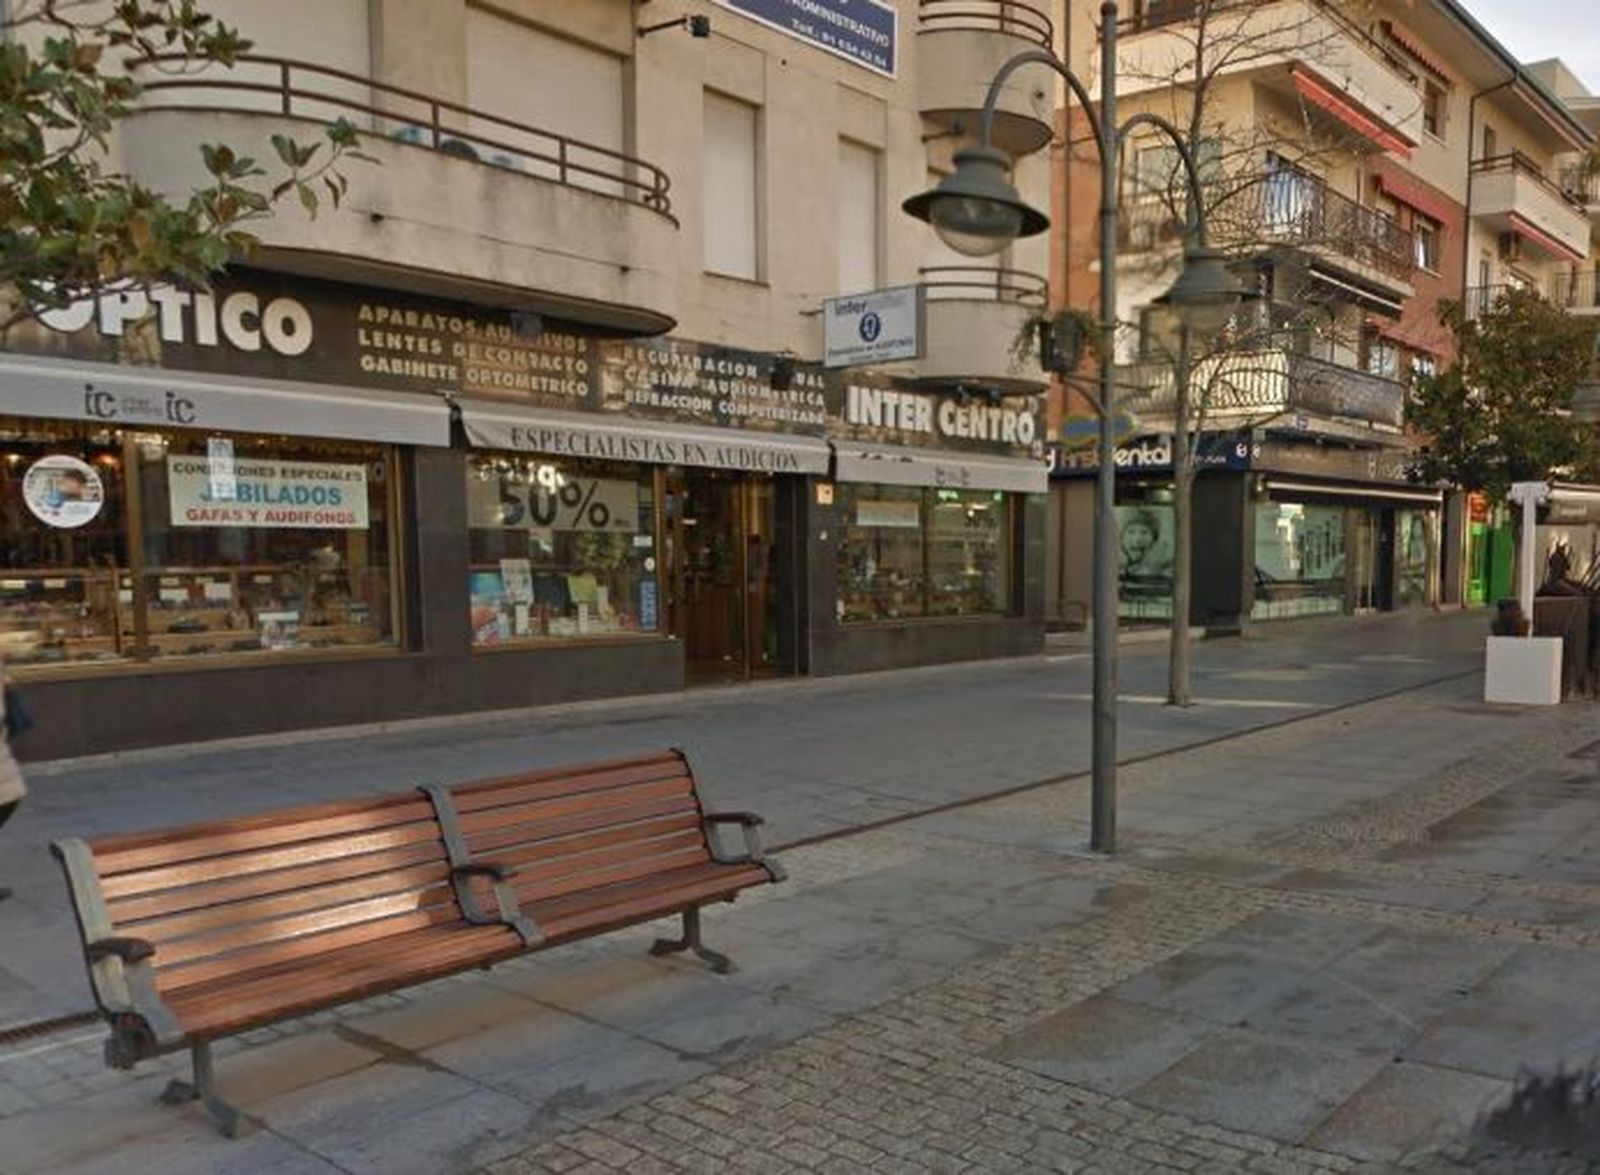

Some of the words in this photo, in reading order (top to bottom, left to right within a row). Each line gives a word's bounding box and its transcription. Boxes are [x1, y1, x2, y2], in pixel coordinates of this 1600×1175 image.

[358, 304, 477, 336] APARATOS
[486, 324, 588, 352] AUIVOS
[358, 329, 443, 355] LENTES
[453, 342, 478, 358] DE
[485, 349, 589, 375] CONTACTO
[361, 354, 458, 381] GABINETE
[466, 367, 589, 397] OPTOMETRICO
[625, 389, 713, 413] REFRACCION
[718, 399, 825, 426] COMPUTERIZADA
[848, 384, 933, 434] INTER
[939, 399, 1036, 446] CENTRO
[511, 426, 677, 463] ESPECIALISTAS
[683, 444, 708, 464] EN
[173, 461, 276, 479] CONIONES
[281, 467, 362, 482] ESPECIALES
[186, 507, 244, 523] GAFAS
[248, 510, 259, 523] Y
[500, 478, 610, 529] 50%
